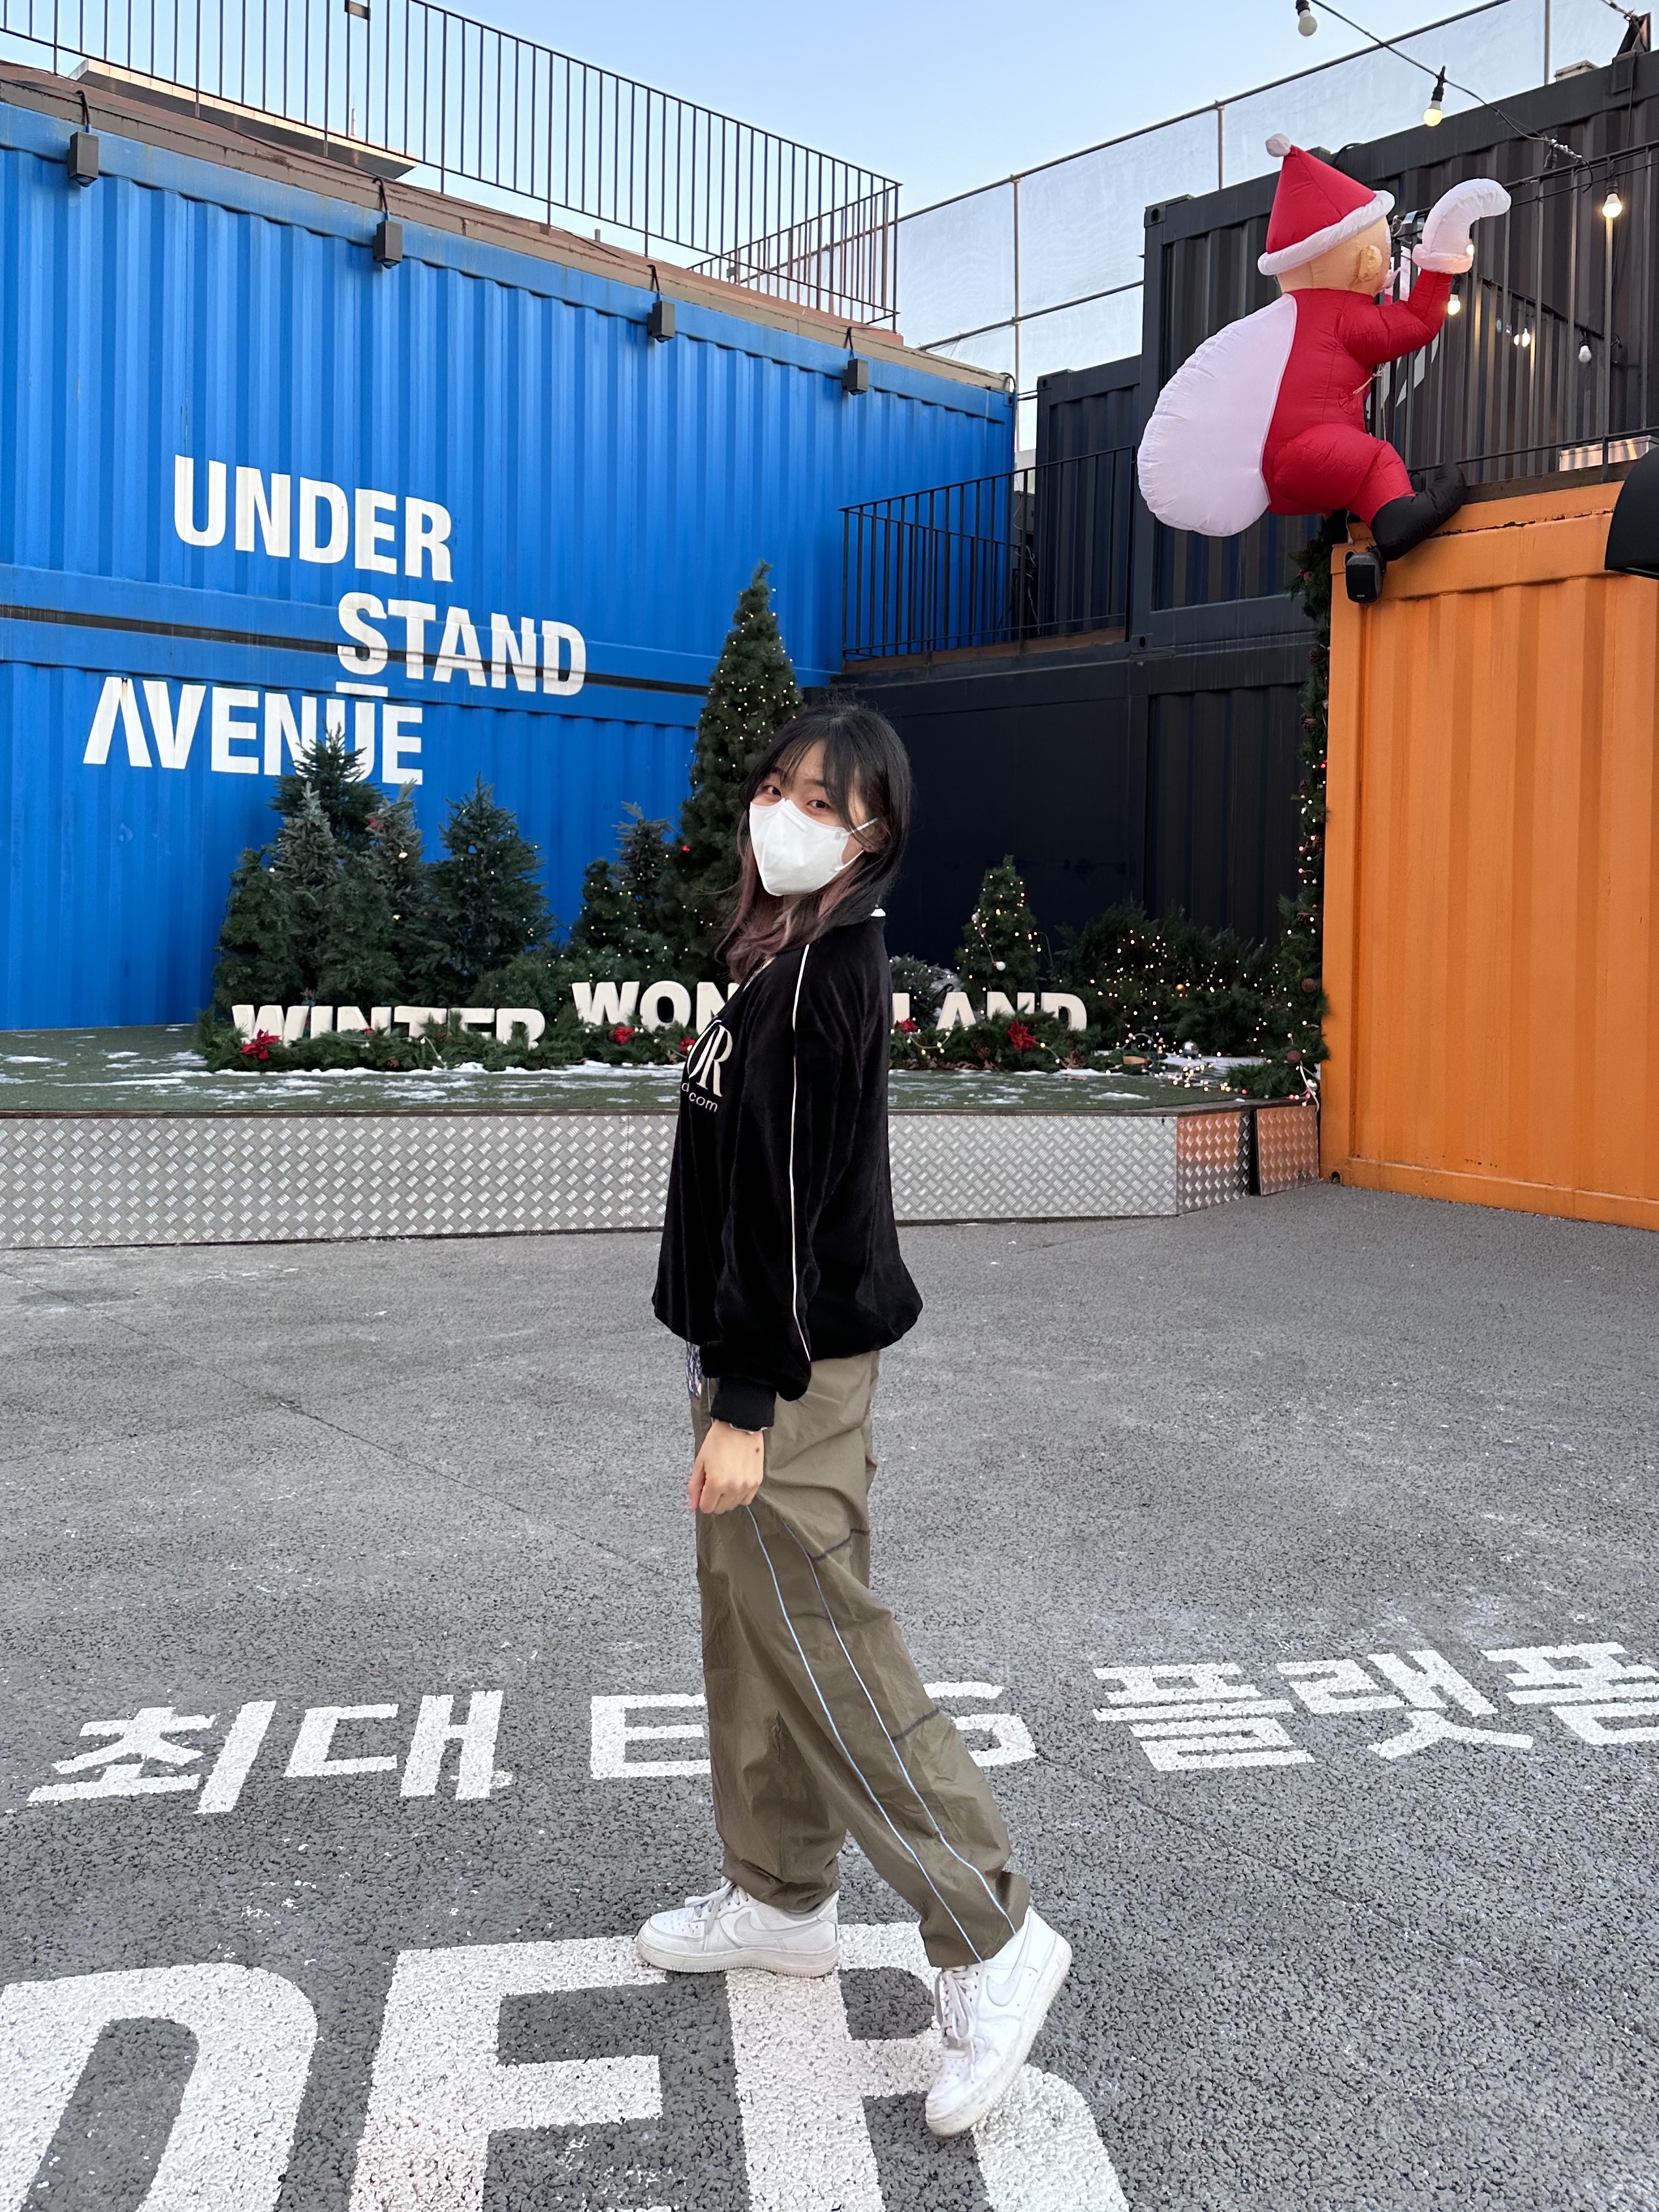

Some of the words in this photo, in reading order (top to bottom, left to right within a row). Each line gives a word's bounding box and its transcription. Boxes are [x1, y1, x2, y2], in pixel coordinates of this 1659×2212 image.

[174, 455, 453, 582] UNDER
[338, 592, 586, 696] STAND
[27, 1690, 504, 1814] 최대
